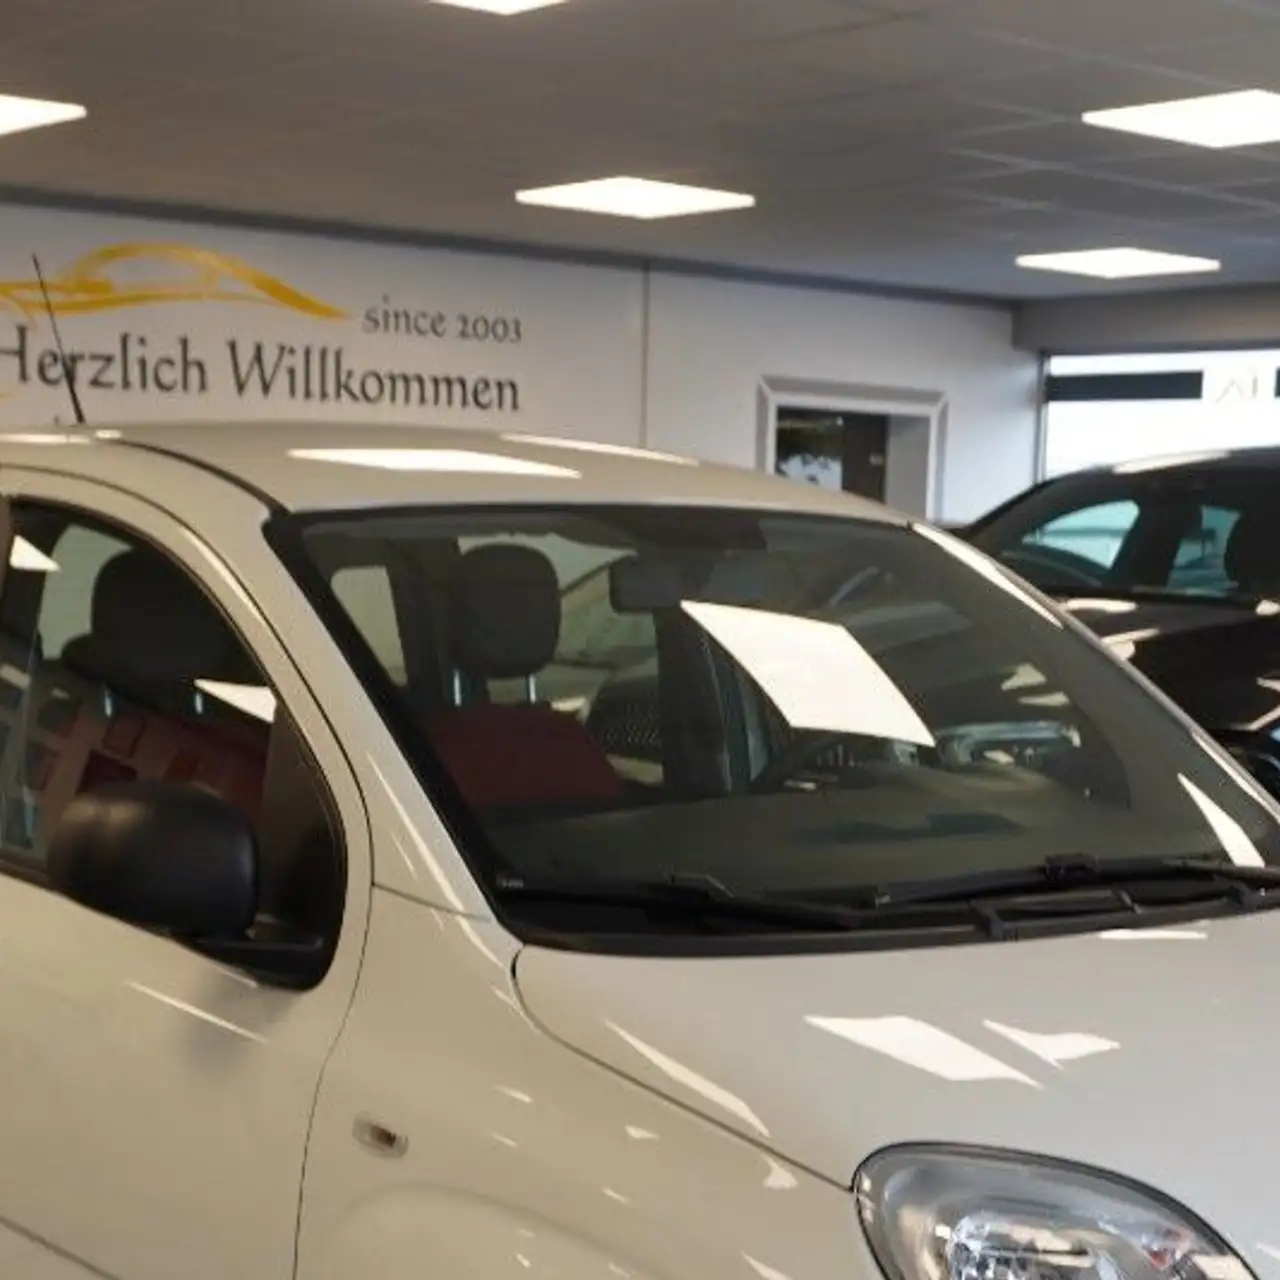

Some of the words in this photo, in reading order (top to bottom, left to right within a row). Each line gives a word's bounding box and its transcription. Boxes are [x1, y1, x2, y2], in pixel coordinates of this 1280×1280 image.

[361, 295, 447, 336] since
[457, 316, 524, 345] 2003
[226, 338, 522, 412] Willkommen
